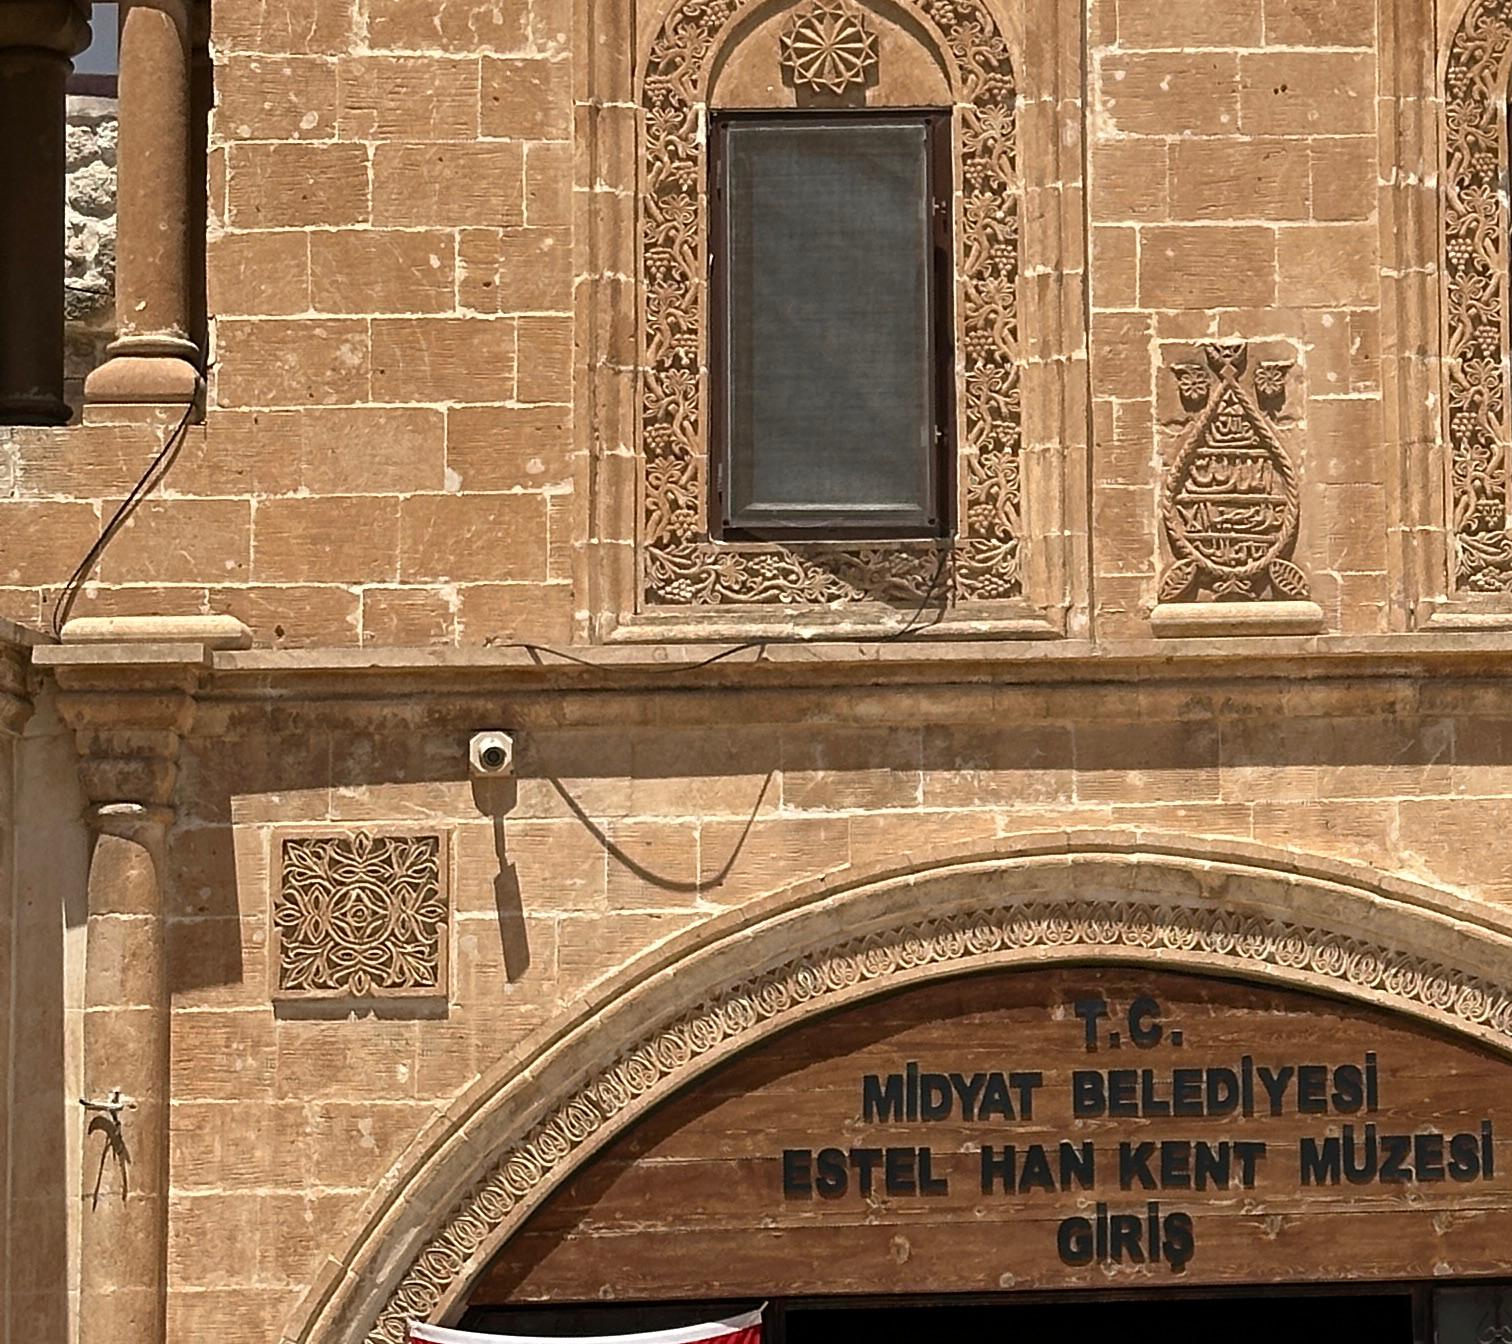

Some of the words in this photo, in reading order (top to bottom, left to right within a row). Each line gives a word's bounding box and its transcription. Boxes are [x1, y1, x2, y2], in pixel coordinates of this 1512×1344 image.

[1075, 996, 1183, 1053] T.C.
[863, 1060, 1043, 1124] MİDYAT
[1072, 1052, 1378, 1119] BELEDİYESİ
[782, 1147, 949, 1201] ESTEL
[980, 1140, 1095, 1197] HAN
[1119, 1140, 1266, 1192] KENT
[1300, 1121, 1494, 1188] MÜZESİ
[1057, 1202, 1195, 1272] GİRİŞ
